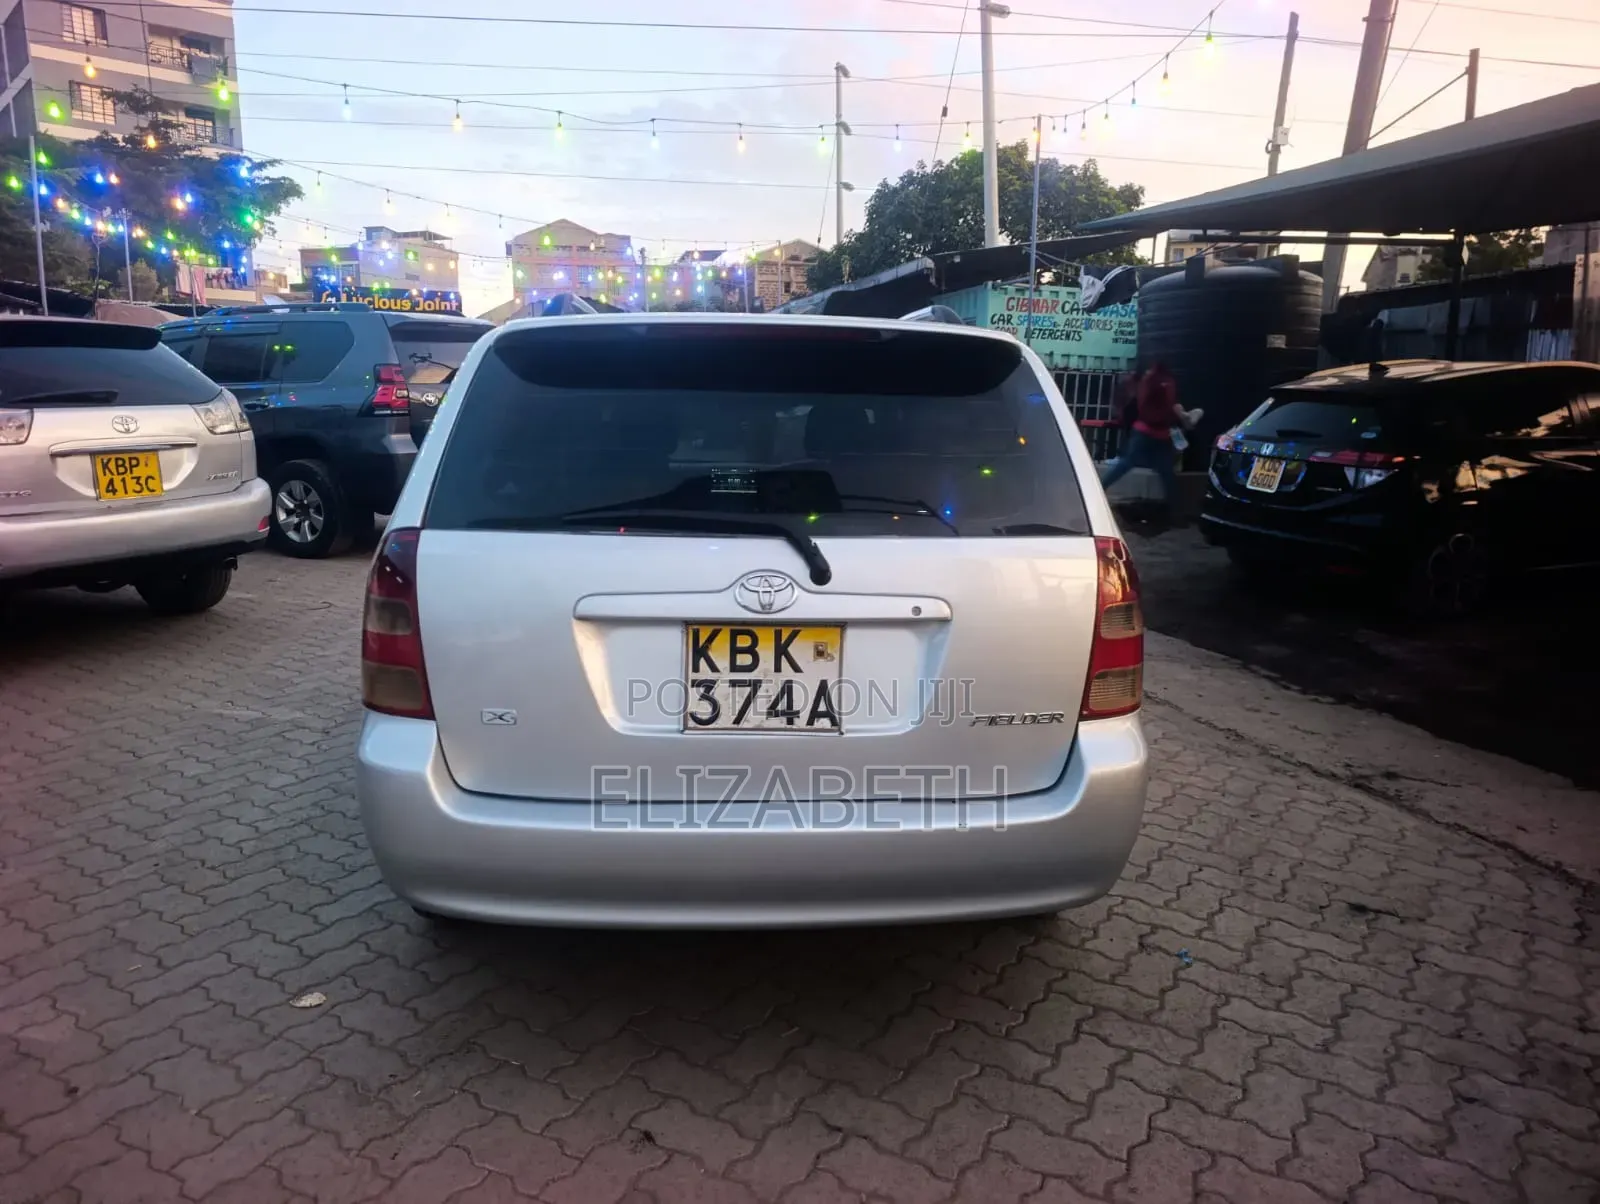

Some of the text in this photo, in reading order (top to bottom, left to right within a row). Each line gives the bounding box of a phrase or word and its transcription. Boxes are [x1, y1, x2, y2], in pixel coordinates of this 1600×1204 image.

[414, 297, 459, 311] Joint
[990, 313, 1013, 326] CAR
[1016, 315, 1054, 328] SPARES
[101, 456, 140, 477] KBP
[105, 475, 157, 496] 413C
[691, 628, 804, 673] KBK
[689, 678, 840, 727] 374A
[969, 711, 1065, 727] FIELDER
